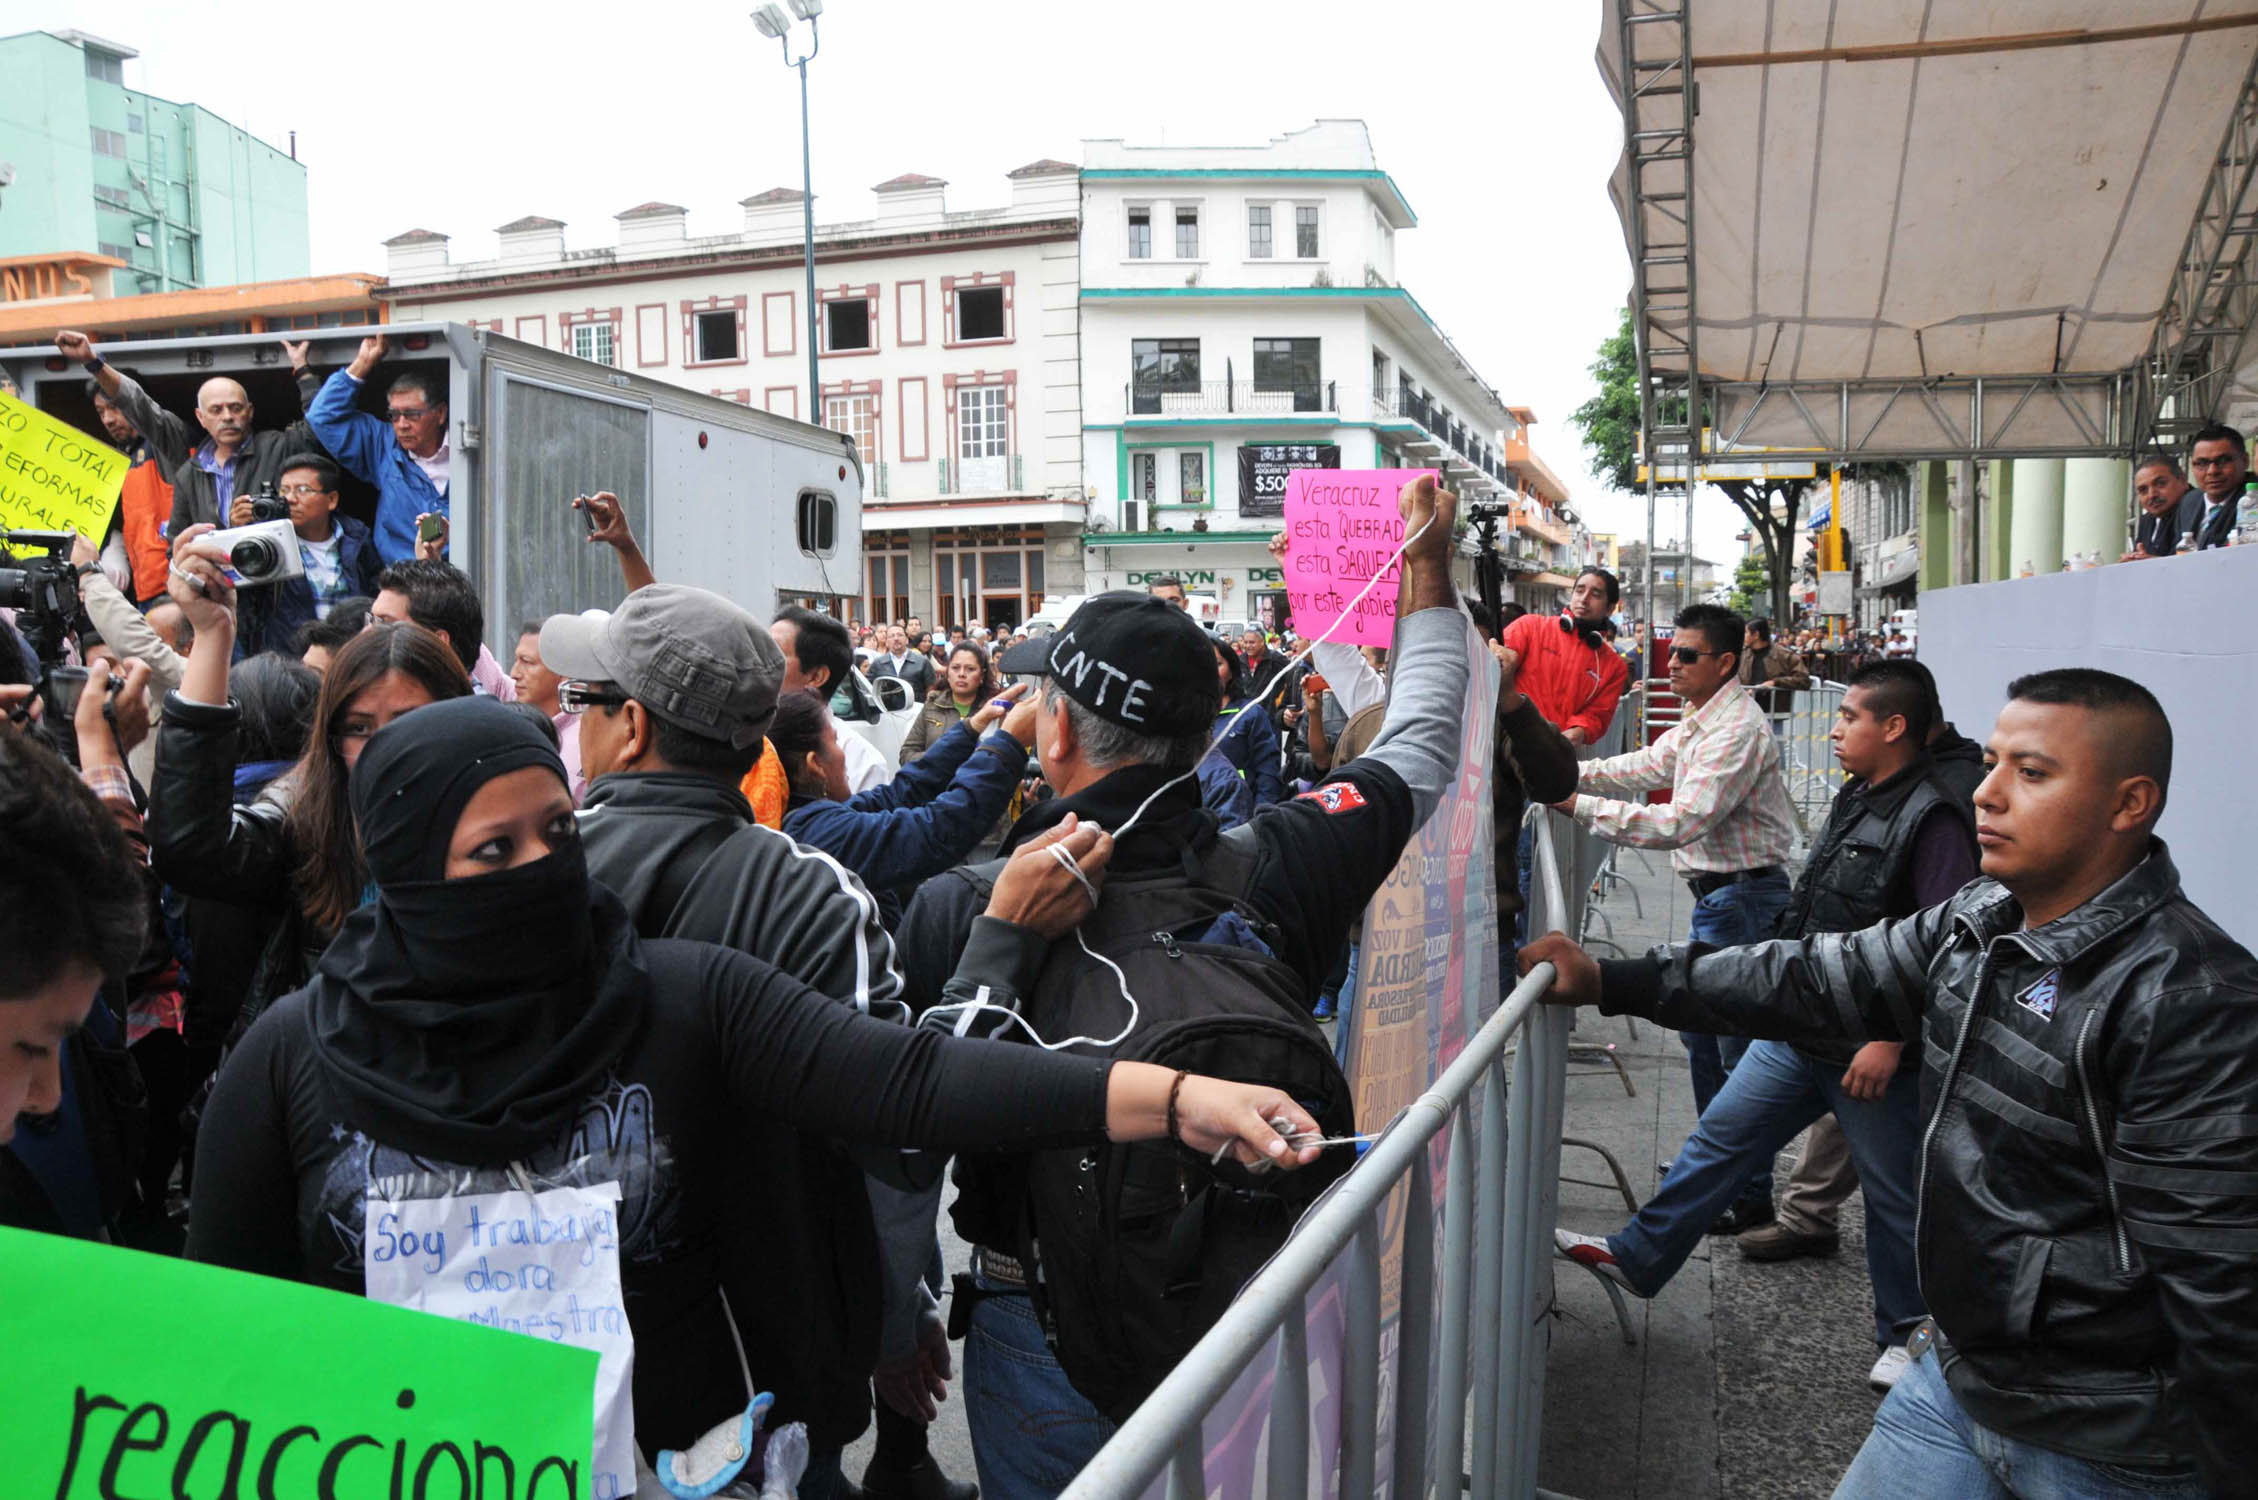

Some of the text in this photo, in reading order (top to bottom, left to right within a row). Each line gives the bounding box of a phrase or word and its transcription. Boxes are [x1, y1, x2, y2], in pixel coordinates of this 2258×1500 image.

[46, 428, 113, 485] TOTAL
[0, 443, 106, 516] EFORMAS
[1300, 477, 1381, 507] Veracruz
[1295, 512, 1331, 540] esta
[1128, 571, 1215, 586] DELYN
[1296, 547, 1332, 575] esta
[1314, 584, 1344, 614] este
[1051, 631, 1154, 723] CNTE
[373, 1213, 445, 1275] Soy
[464, 1255, 555, 1293] dora
[55, 1386, 580, 1500] reacciona
